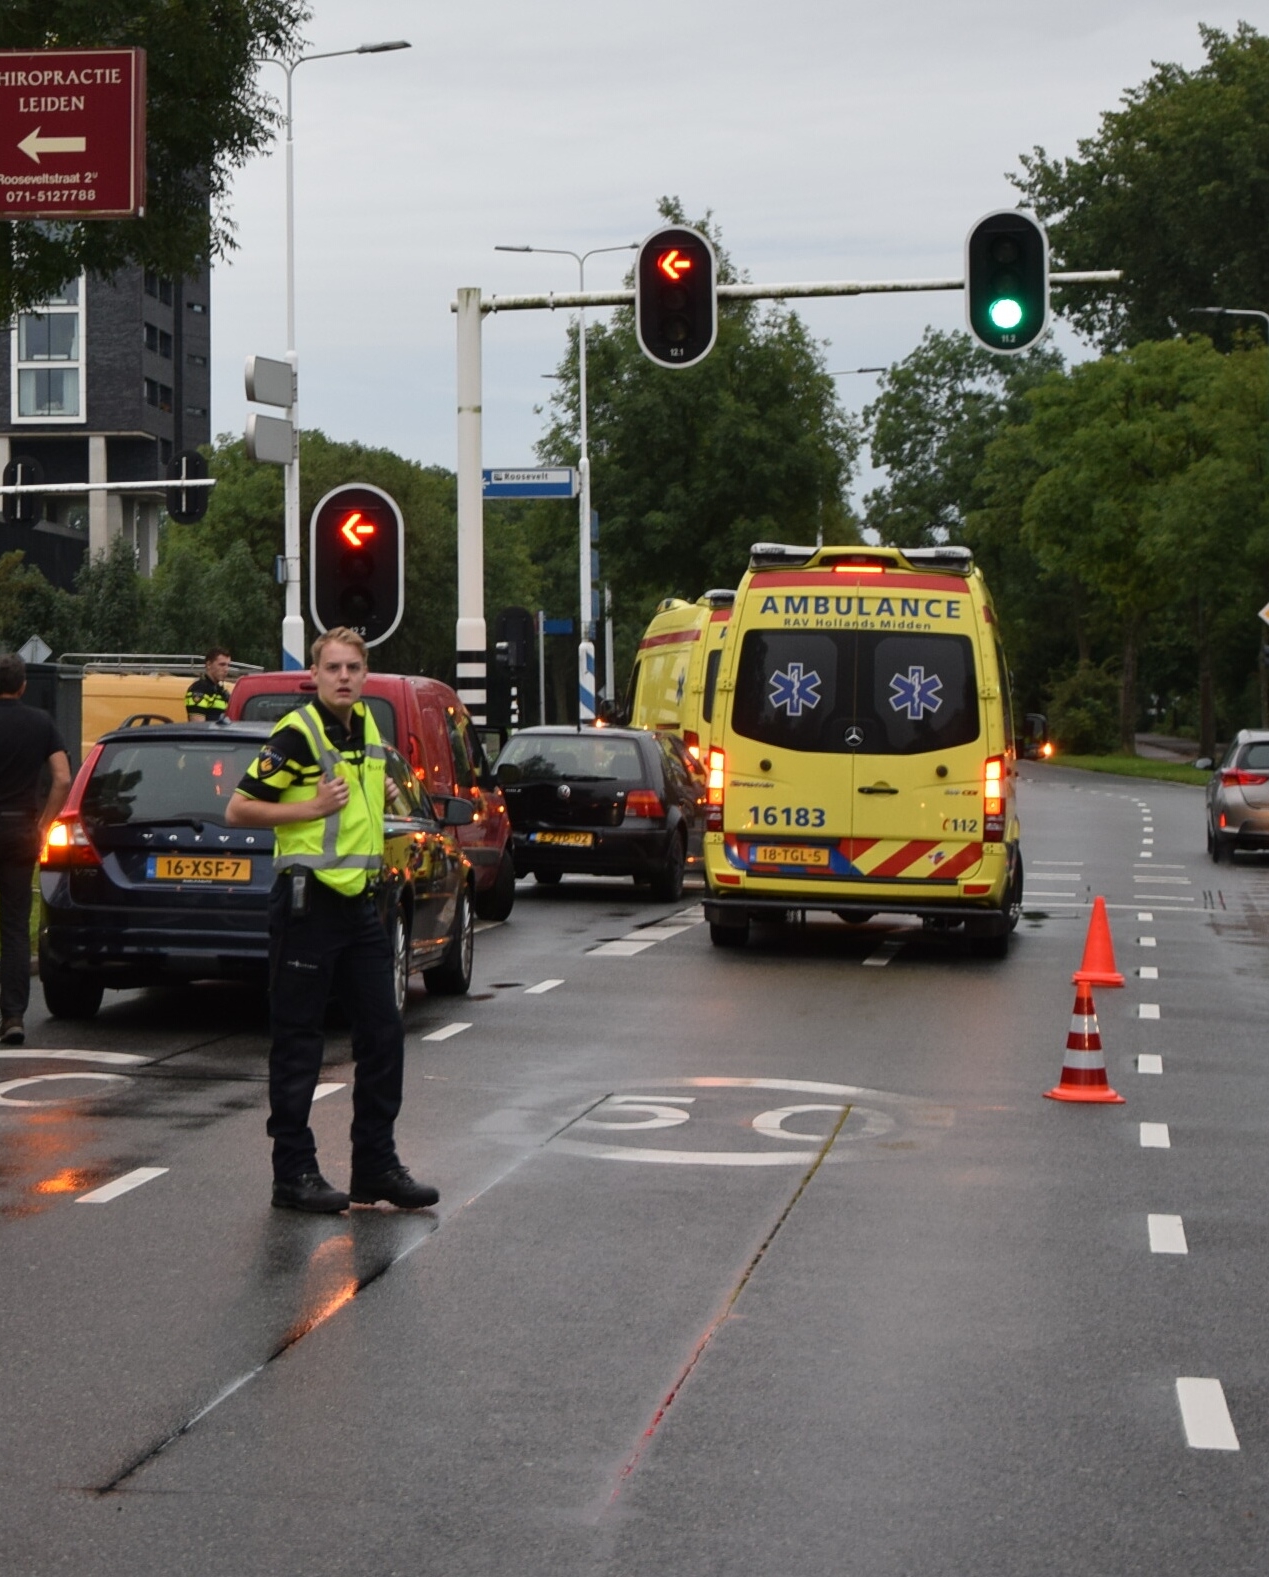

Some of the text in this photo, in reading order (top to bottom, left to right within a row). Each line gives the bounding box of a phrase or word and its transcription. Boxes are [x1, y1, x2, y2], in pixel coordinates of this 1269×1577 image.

[19, 96, 85, 112] LEIDEN
[6, 190, 96, 203] 071-5127788
[760, 595, 961, 619] AMBULANCE
[784, 618, 931, 630] RAV Hollands Midden
[749, 806, 826, 828] 16183
[952, 819, 978, 833] 112
[142, 833, 255, 844] VOLVO
[762, 849, 822, 862] 18-TGL-5
[166, 859, 242, 877] 16-XSF-7
